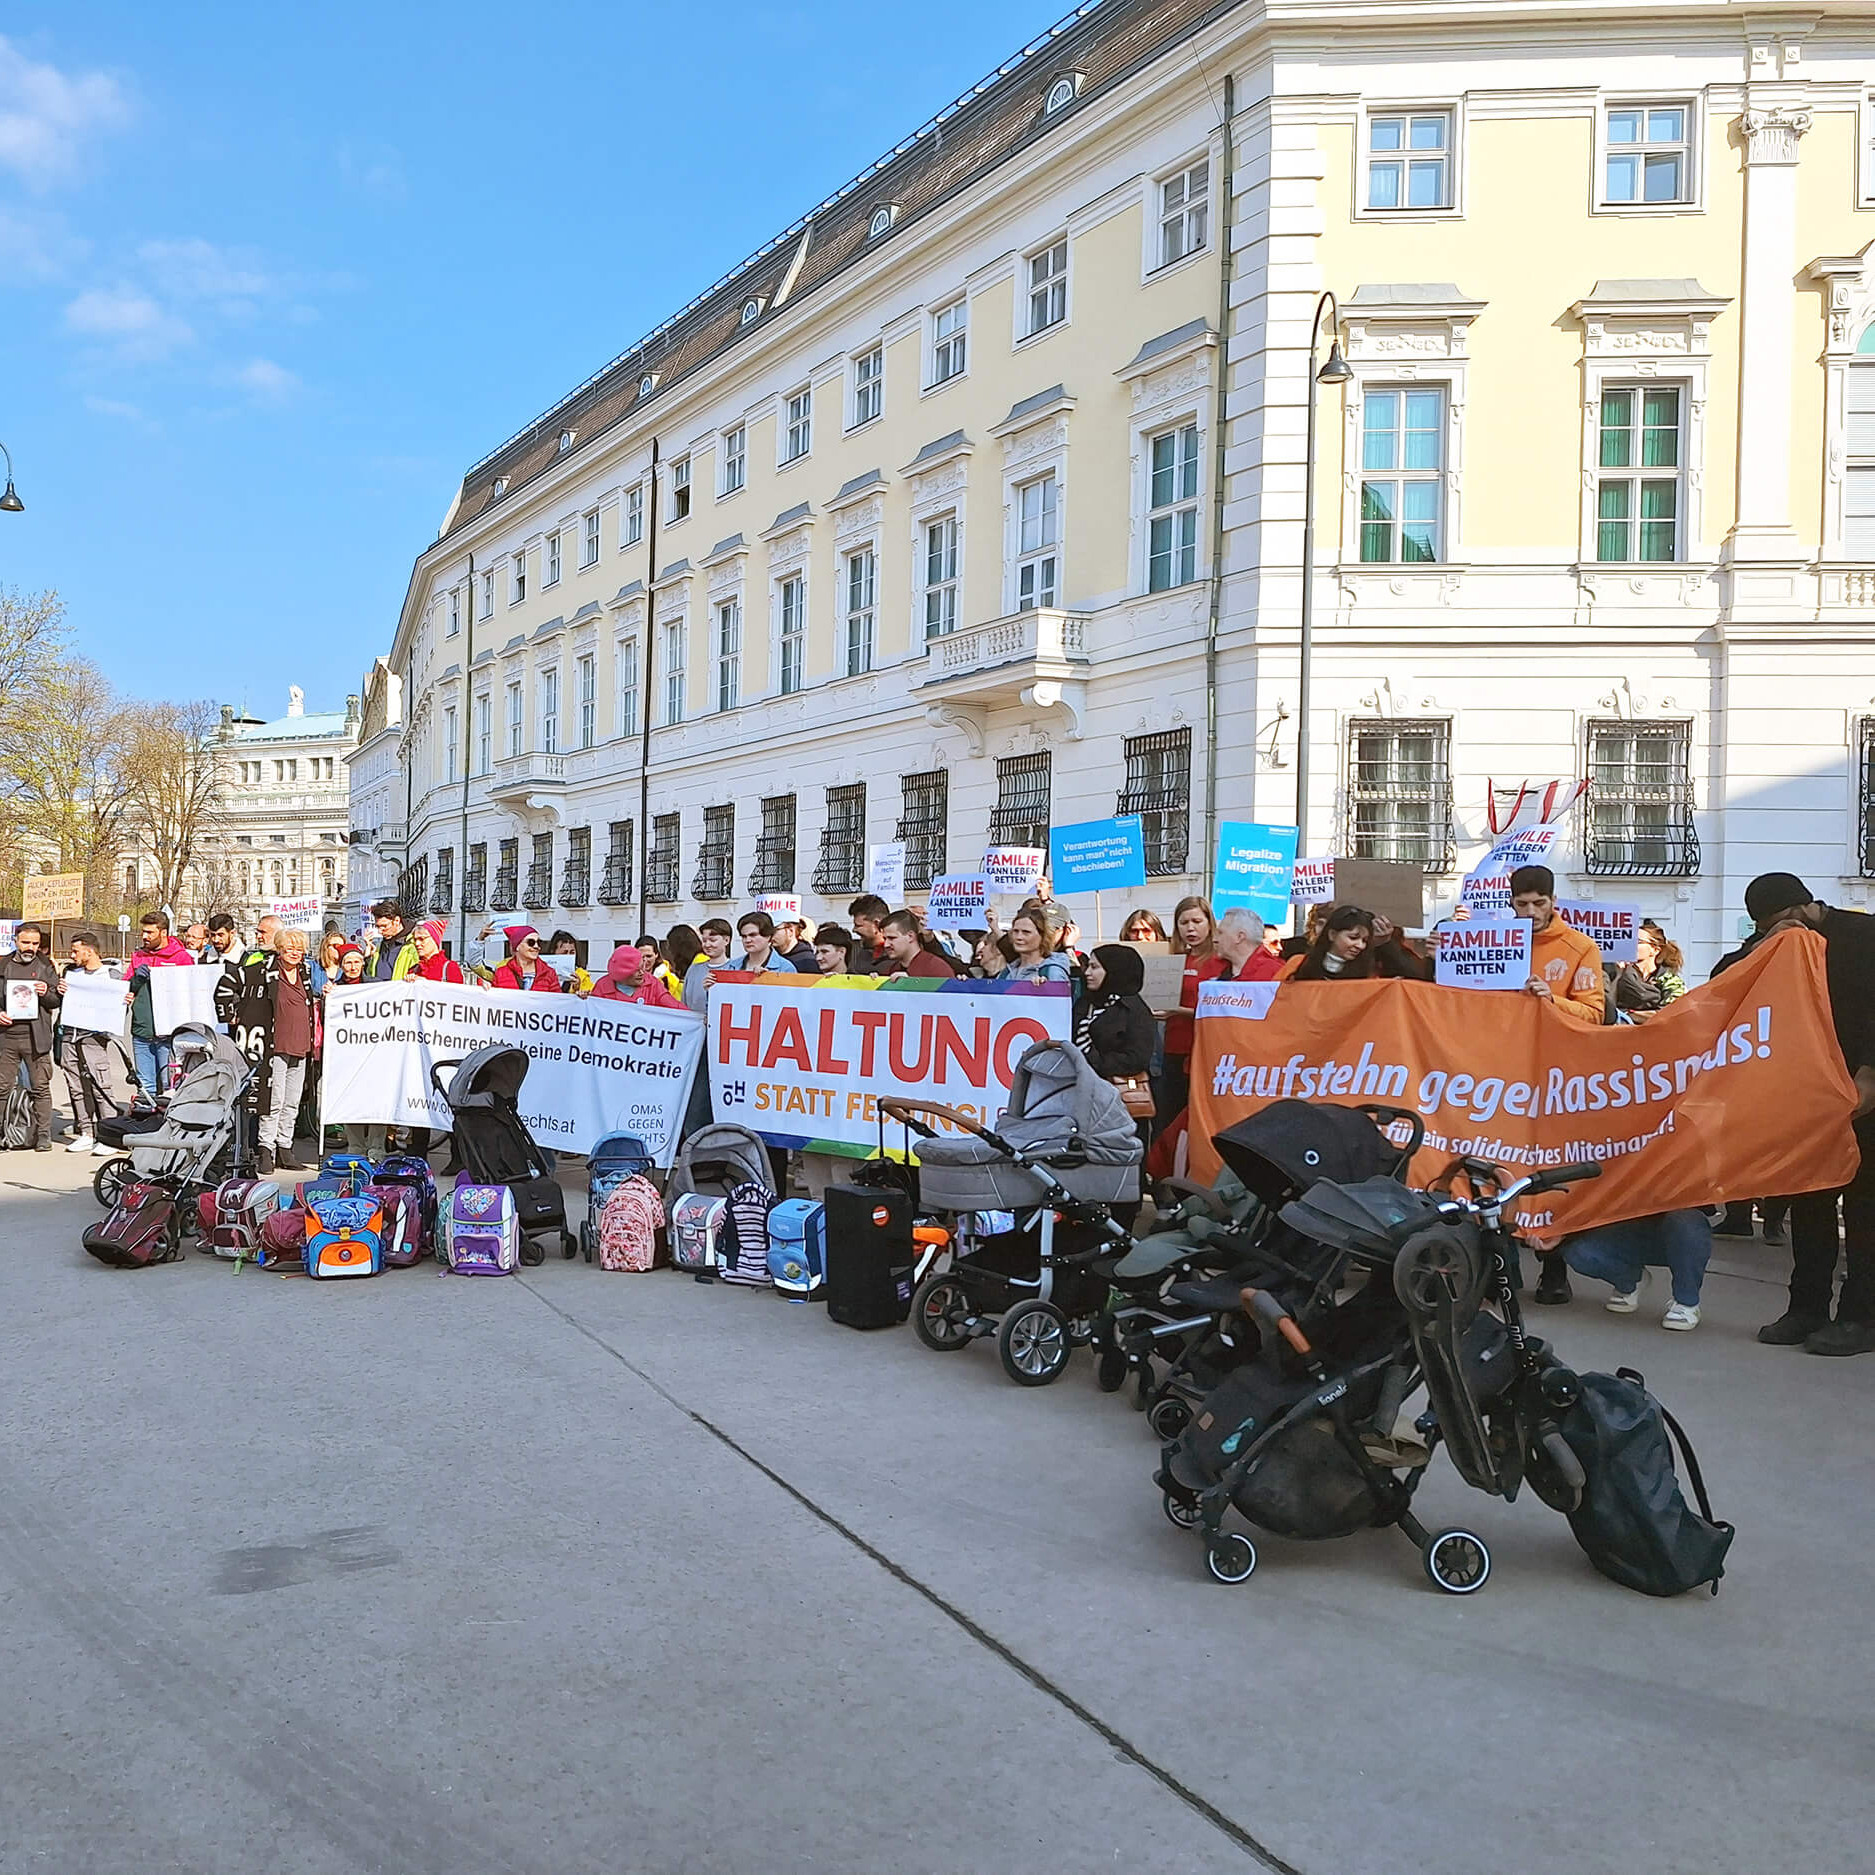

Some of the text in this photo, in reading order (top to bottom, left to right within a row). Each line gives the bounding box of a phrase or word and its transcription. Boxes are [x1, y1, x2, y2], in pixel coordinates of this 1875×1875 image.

[1062, 836, 1128, 852] Verantwortung
[1513, 843, 1547, 853] LEBEN
[986, 854, 1040, 866] FAMILIE
[1062, 854, 1084, 863] kann
[1109, 846, 1133, 857] nicht
[1230, 847, 1283, 861] Legalize
[1010, 867, 1039, 875] LEBEN
[1071, 858, 1126, 873] abschieben!
[1225, 860, 1285, 875] Migration
[1294, 863, 1335, 877] MILIE
[994, 876, 1026, 884] RETTEN
[1464, 876, 1512, 892] FAMIL
[932, 881, 984, 897] FAMILIE
[1463, 890, 1511, 901] KANN LEB
[274, 899, 319, 913] FAMILIE
[954, 897, 984, 906] LEBEN
[297, 909, 319, 919] LEBEN
[937, 908, 973, 917] RETTEN
[1554, 907, 1633, 928] AMILIE
[1439, 928, 1525, 949] FAMILIE
[1440, 949, 1525, 963] KANN LEBEN
[1455, 963, 1506, 976] RETTEN
[343, 999, 683, 1051] FLUCHT IST EIN MENSCHENRECHT
[336, 1028, 380, 1045] Ohne
[520, 1040, 562, 1061] keine
[568, 1045, 683, 1079] Demokratie
[1212, 1042, 1409, 1099] #aufstehn
[755, 1082, 840, 1118] STATT
[630, 1104, 664, 1115] OMAS
[627, 1118, 664, 1130] GEGEN
[1421, 1130, 1449, 1152] ein
